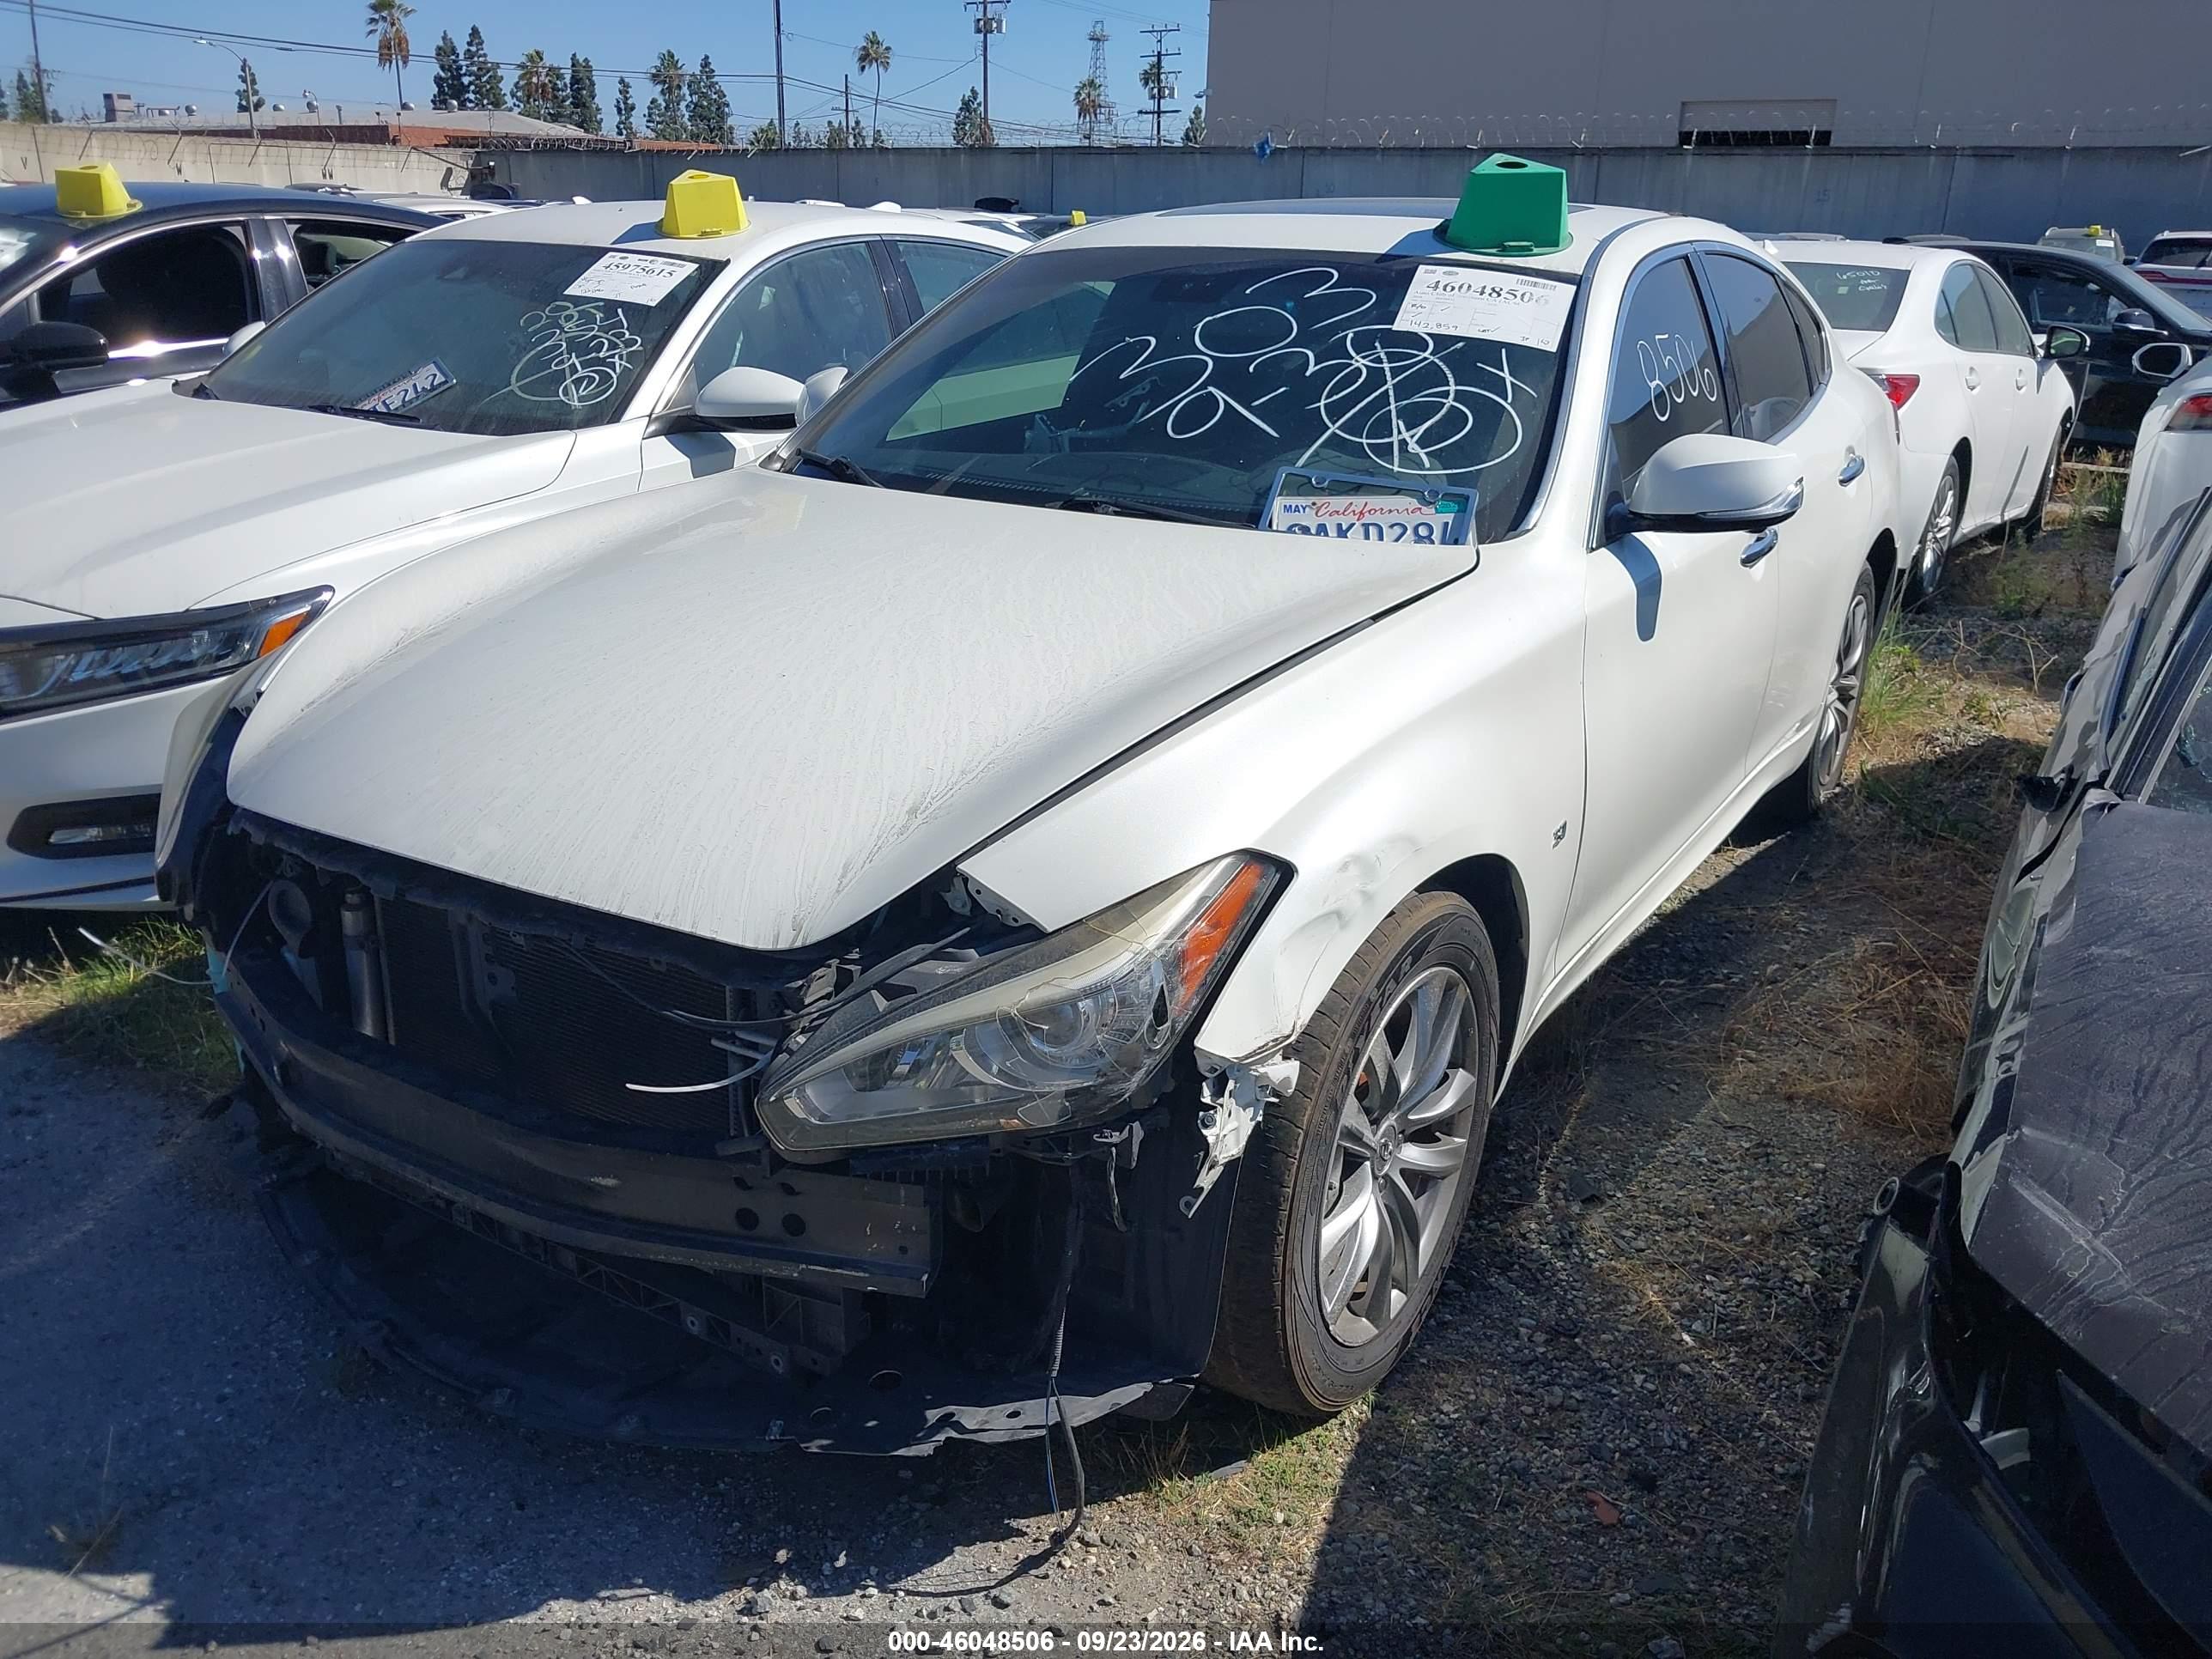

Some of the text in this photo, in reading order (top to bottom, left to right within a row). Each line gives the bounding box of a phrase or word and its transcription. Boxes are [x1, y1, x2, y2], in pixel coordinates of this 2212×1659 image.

[602, 262, 678, 279] 45975615
[1426, 280, 1550, 306] 46048506
[1637, 333, 1717, 422] 8506
[1284, 504, 1307, 514] MAY
[1314, 501, 1435, 522] California
